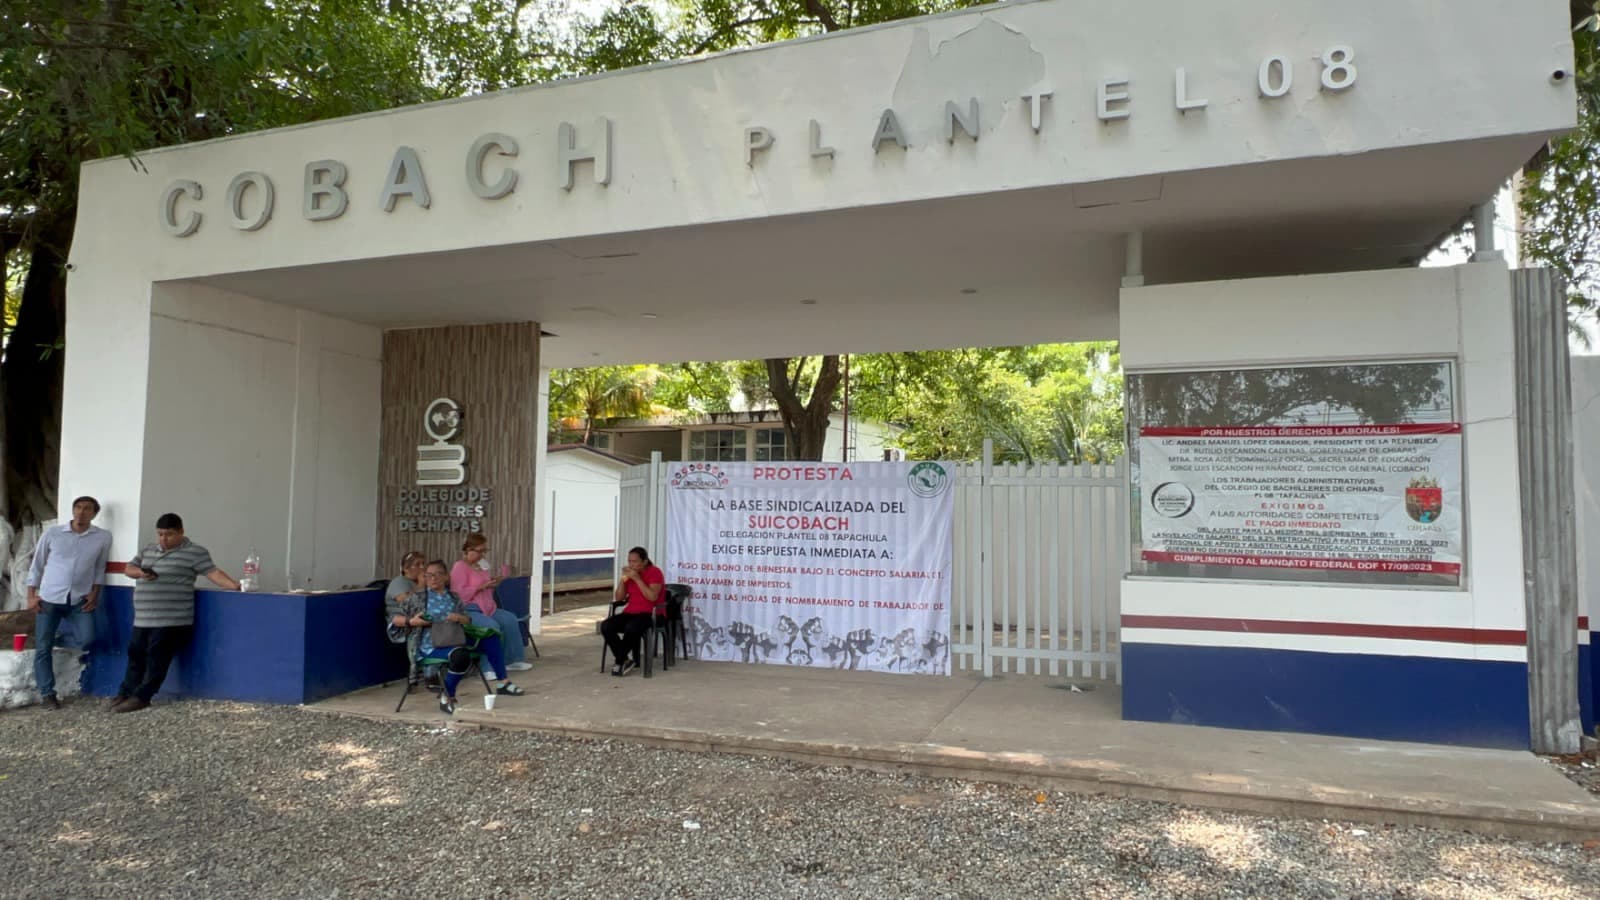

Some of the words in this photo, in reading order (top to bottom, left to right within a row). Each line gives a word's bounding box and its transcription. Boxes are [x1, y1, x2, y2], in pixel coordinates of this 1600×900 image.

[159, 115, 613, 238] COBACH
[745, 67, 1208, 167] PLANTEL
[1257, 44, 1358, 98] 08
[1279, 428, 1333, 436] DERECHOS
[1335, 426, 1400, 435] LABORALES!
[753, 466, 853, 481] PROTESTA
[400, 488, 465, 502] COLEGIO
[468, 488, 490, 501] DE
[394, 505, 484, 518] BACHILLERES
[710, 500, 727, 511] LA
[730, 500, 766, 512] BASE
[766, 500, 874, 513] SINDICALIZADA
[880, 501, 906, 514] DEL
[749, 515, 849, 530] SUICOBACH
[1237, 511, 1303, 519] AUTORIDADES
[1305, 512, 1380, 520] COMPETENTES
[400, 519, 416, 531] DE
[418, 519, 480, 532] CHIAPAS
[777, 532, 817, 541] PLANTEL
[831, 533, 888, 542] TAPACHULA
[711, 544, 744, 555] EXIGE
[747, 545, 807, 557] RESPUESTA
[810, 547, 875, 559] INMEDIATA
[880, 548, 895, 560] A:
[1174, 555, 1244, 565] CUMPLIMIENTO
[1246, 558, 1257, 566] AL
[1260, 559, 1307, 567] MANDATO
[1309, 560, 1355, 569] FEDERAL
[701, 563, 714, 571] DEL
[717, 564, 741, 572] BONO
[757, 566, 797, 574] BIENESTAR
[800, 567, 823, 575] BAJO
[826, 568, 834, 576] EL
[838, 568, 886, 577] CONCEPTO
[688, 577, 734, 587] GRAVAMEN
[736, 579, 745, 587] DE
[742, 594, 768, 602] HOJAS
[785, 597, 855, 607] NOMBRAMIENTO
[859, 600, 870, 608] DE
[933, 603, 944, 611] DE
